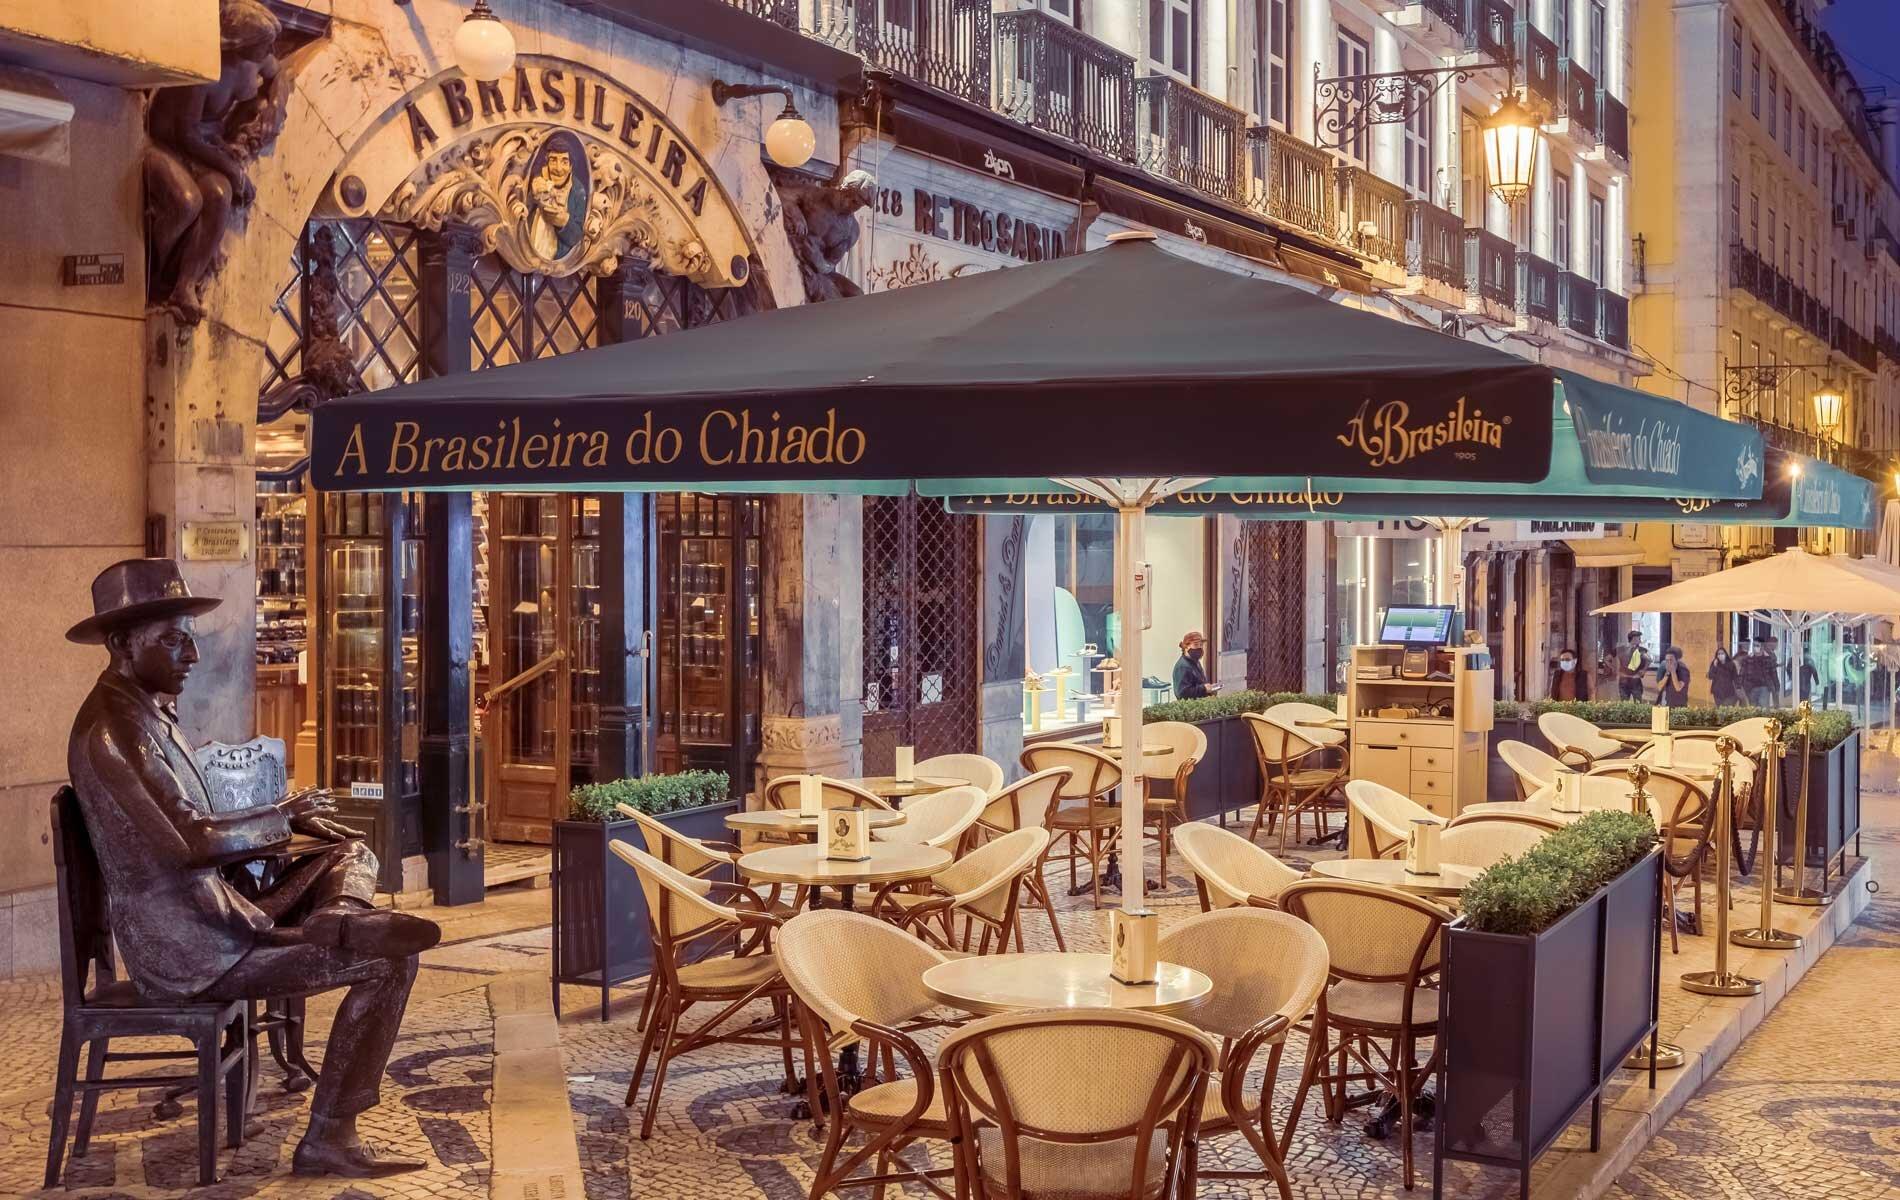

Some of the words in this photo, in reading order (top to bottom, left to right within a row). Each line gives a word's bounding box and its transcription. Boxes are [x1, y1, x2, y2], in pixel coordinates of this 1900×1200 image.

[404, 101, 440, 153] A
[439, 67, 709, 217] BRASILEIRA
[450, 272, 470, 295] 122
[624, 299, 642, 320] 120
[334, 422, 369, 477] A
[385, 416, 610, 474] Brasileira
[625, 410, 684, 465] do
[700, 407, 867, 466] Chiado
[1336, 398, 1384, 456] A
[1369, 395, 1503, 468] Brasileira
[1454, 452, 1477, 461] 1905
[1634, 417, 1648, 471] do
[1650, 419, 1682, 476] Chiado
